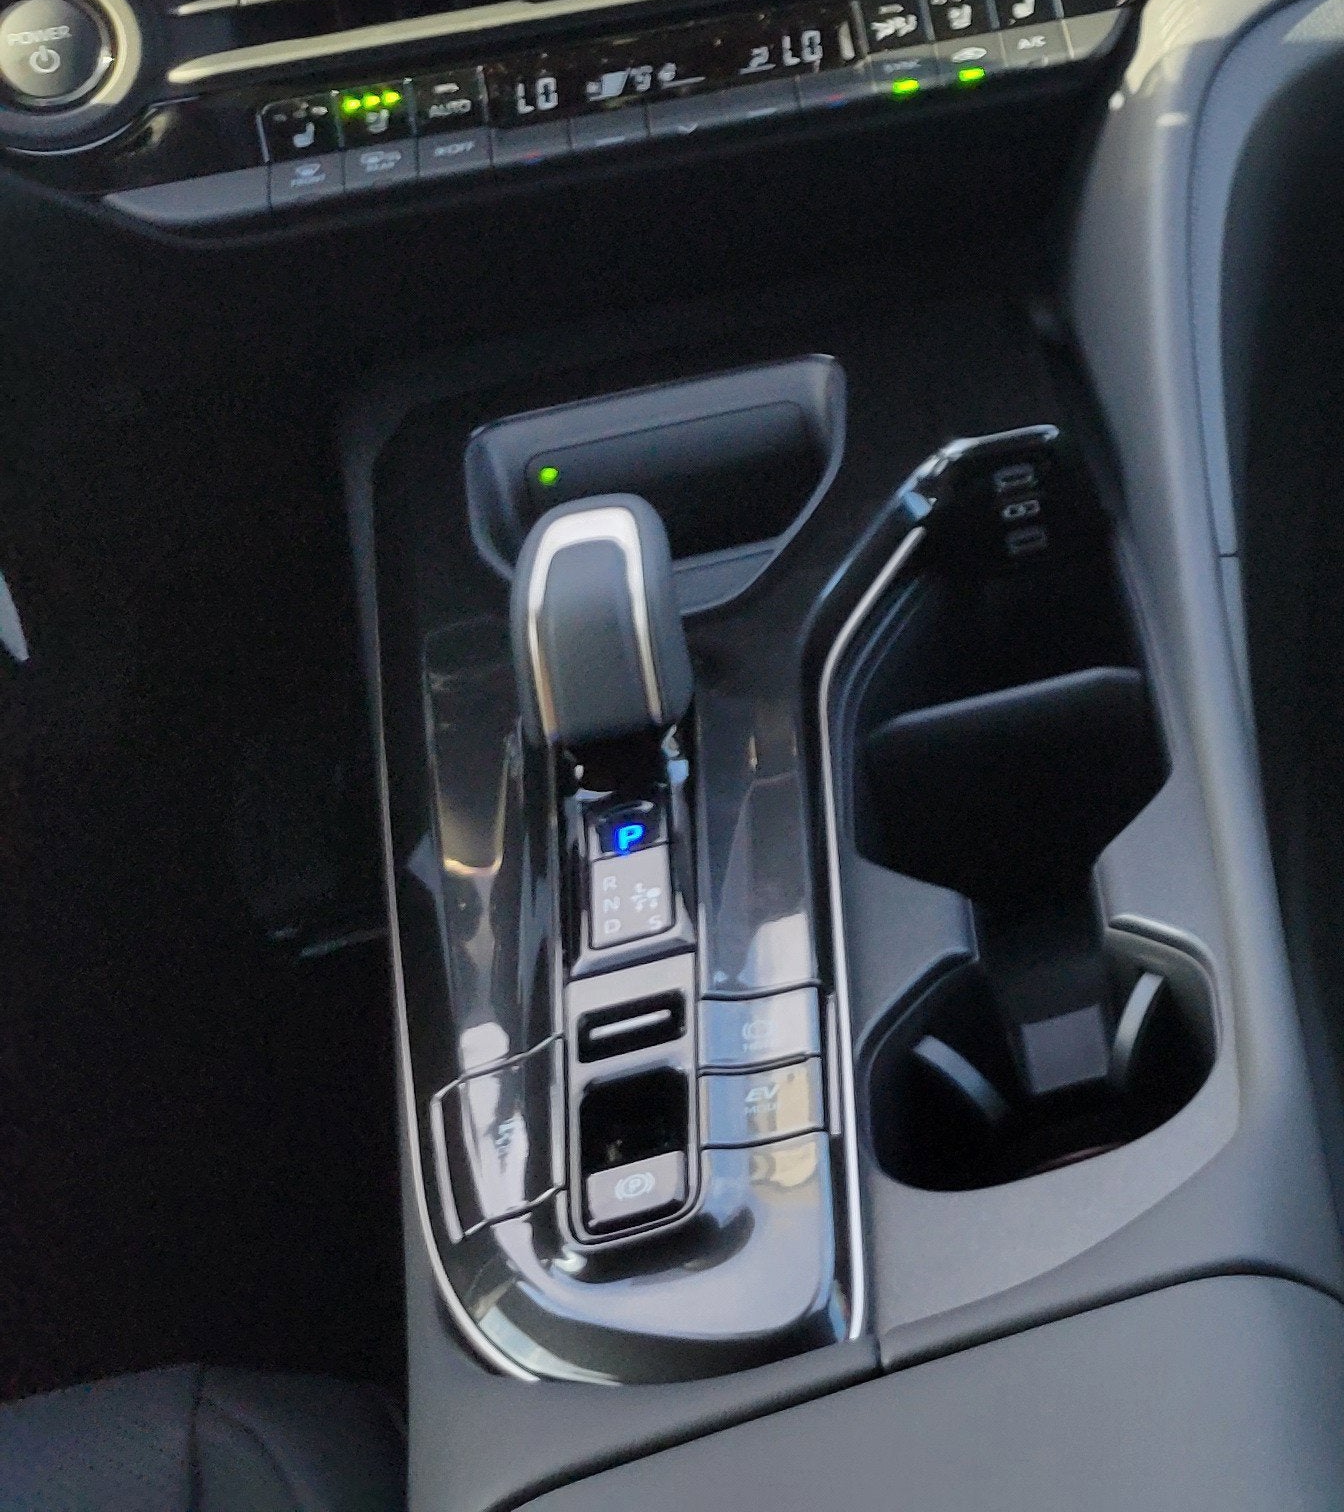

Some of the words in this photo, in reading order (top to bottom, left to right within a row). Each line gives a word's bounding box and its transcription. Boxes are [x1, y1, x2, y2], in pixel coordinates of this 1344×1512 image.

[7, 25, 73, 46] POWER
[616, 822, 646, 852] P
[602, 875, 618, 892] R
[602, 895, 620, 913] N
[604, 918, 621, 934] D
[648, 914, 663, 930] S
[744, 1082, 781, 1103] EV
